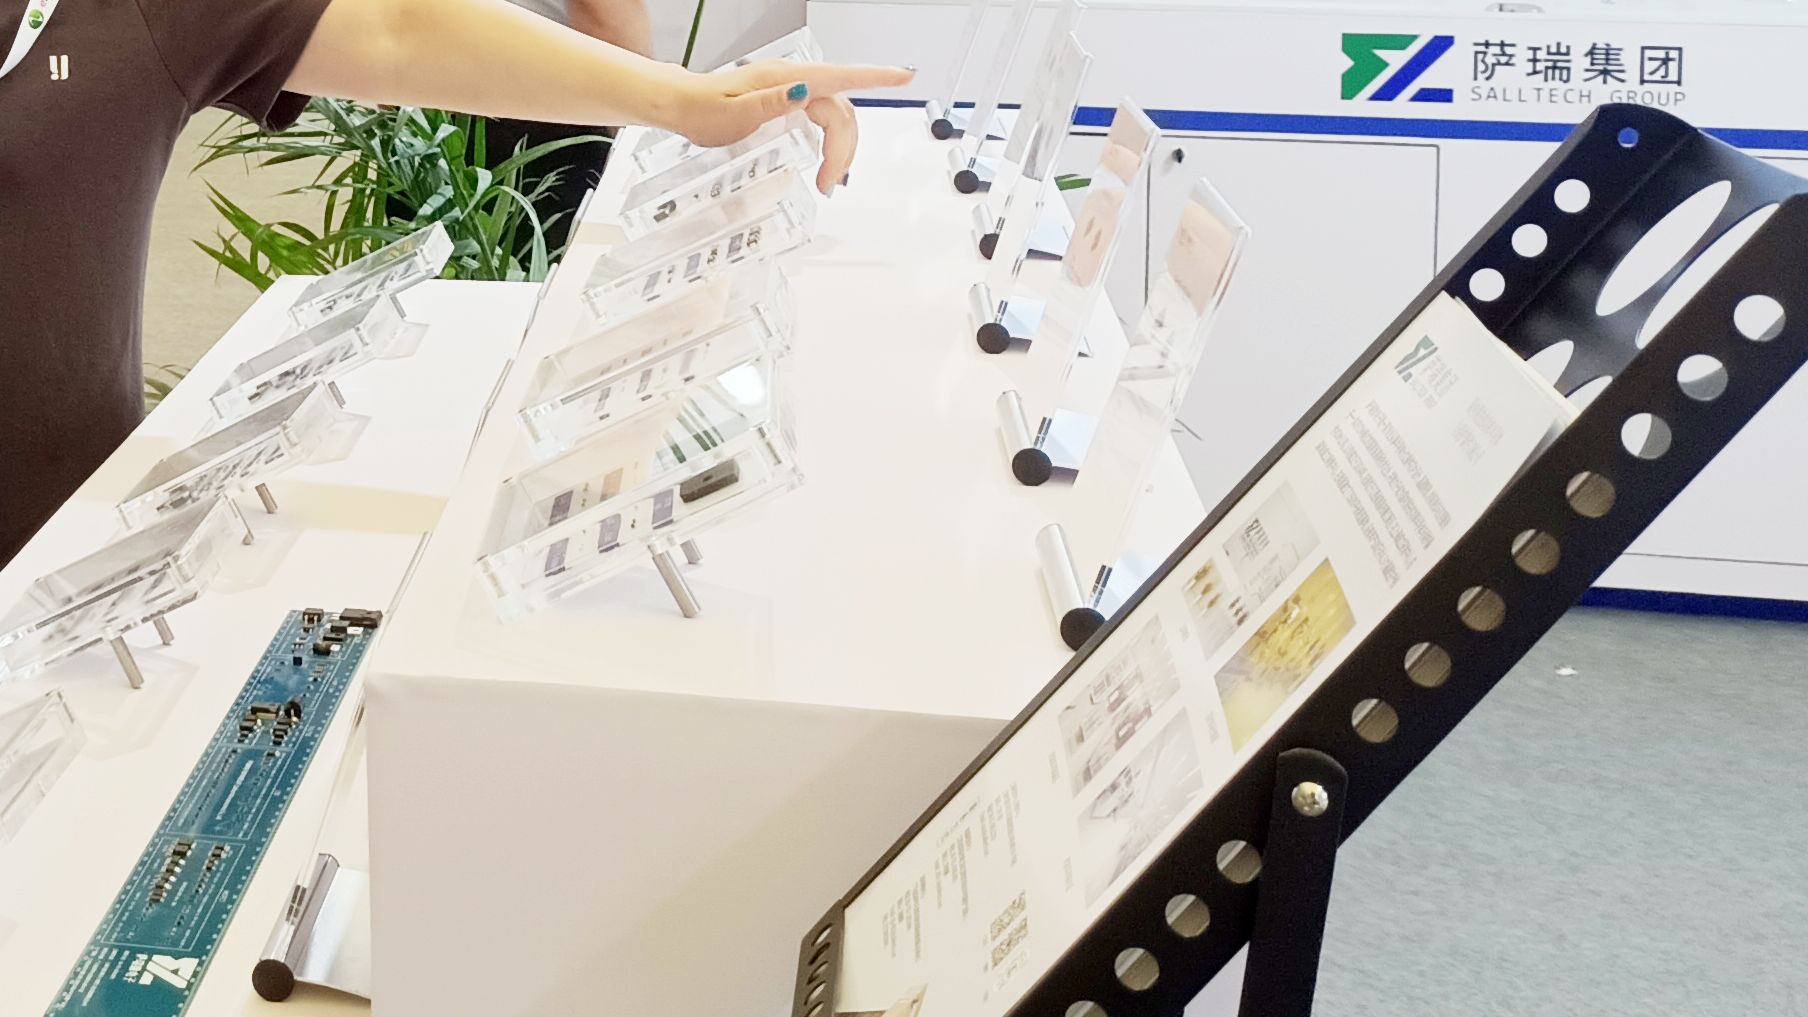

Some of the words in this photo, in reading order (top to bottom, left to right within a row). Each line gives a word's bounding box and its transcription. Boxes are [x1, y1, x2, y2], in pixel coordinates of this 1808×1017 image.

[1472, 39, 1684, 87] 萨瑞集团
[1470, 85, 1592, 105] SALLTECH
[1609, 88, 1687, 107] GROUP
